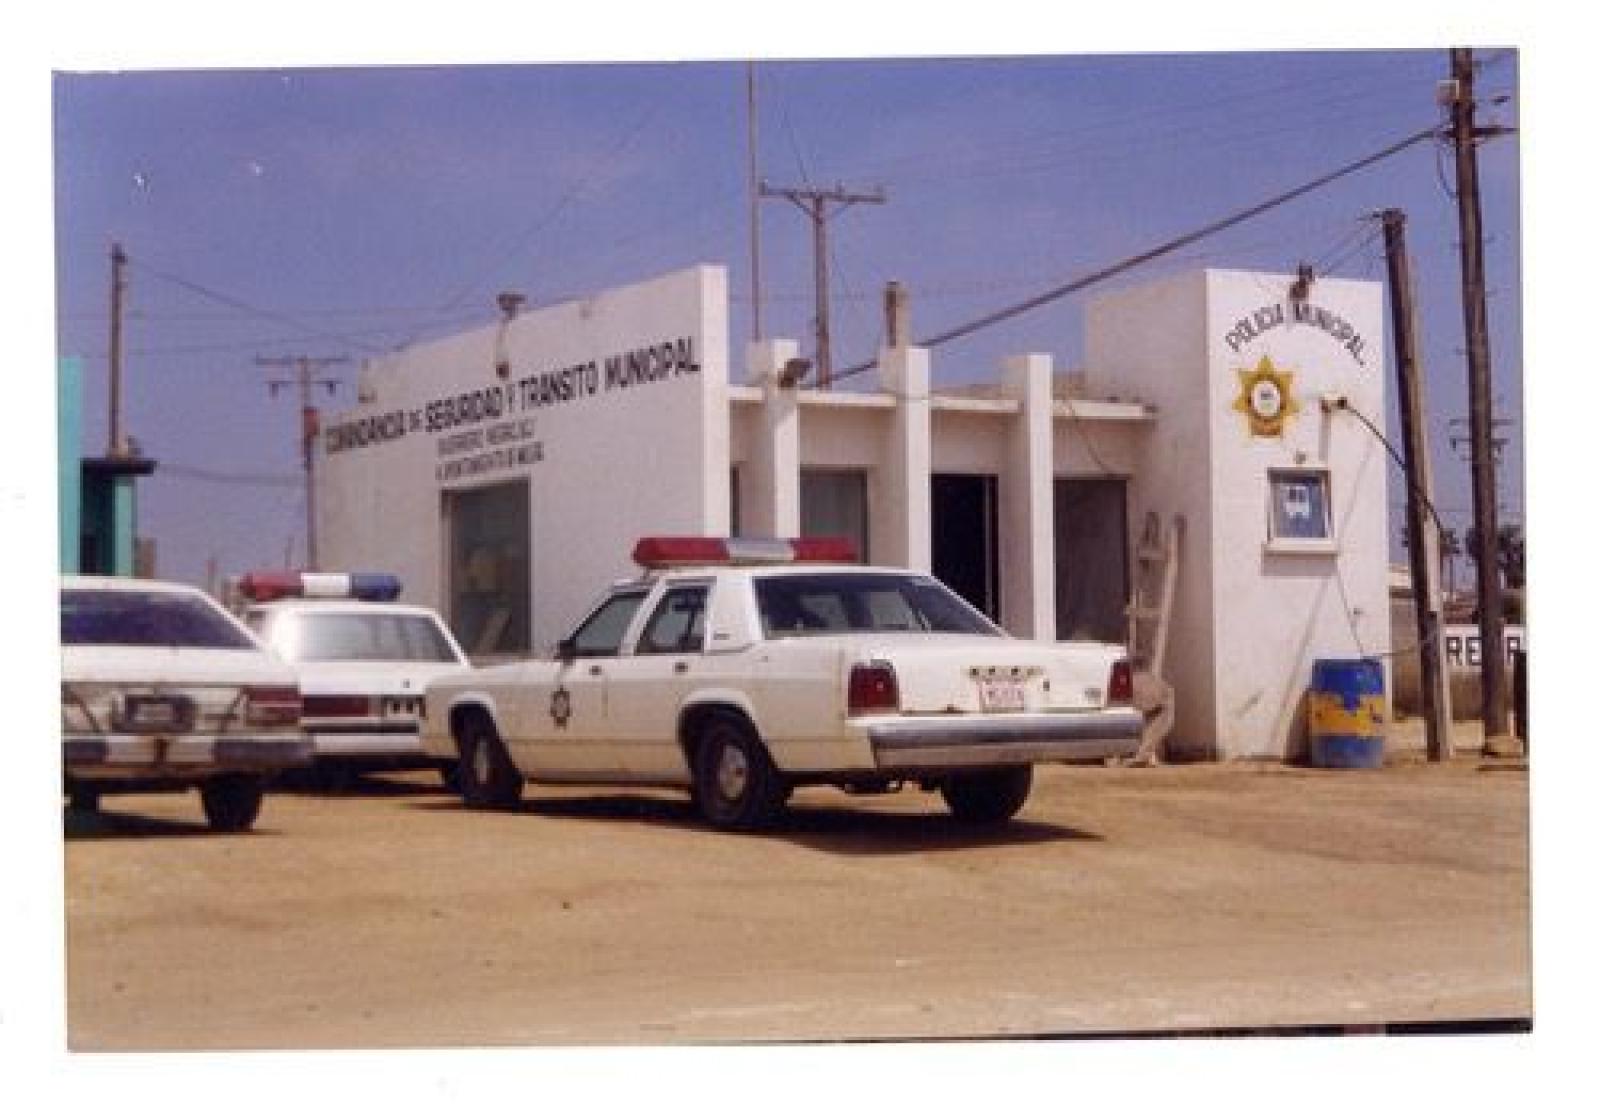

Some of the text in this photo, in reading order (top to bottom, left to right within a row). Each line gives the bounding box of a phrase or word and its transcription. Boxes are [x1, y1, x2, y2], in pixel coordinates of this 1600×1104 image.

[426, 386, 502, 433] SEGURIDAD
[505, 383, 516, 414] Y
[519, 361, 598, 411] TRANSITO
[605, 336, 700, 391] MUNICIPAL
